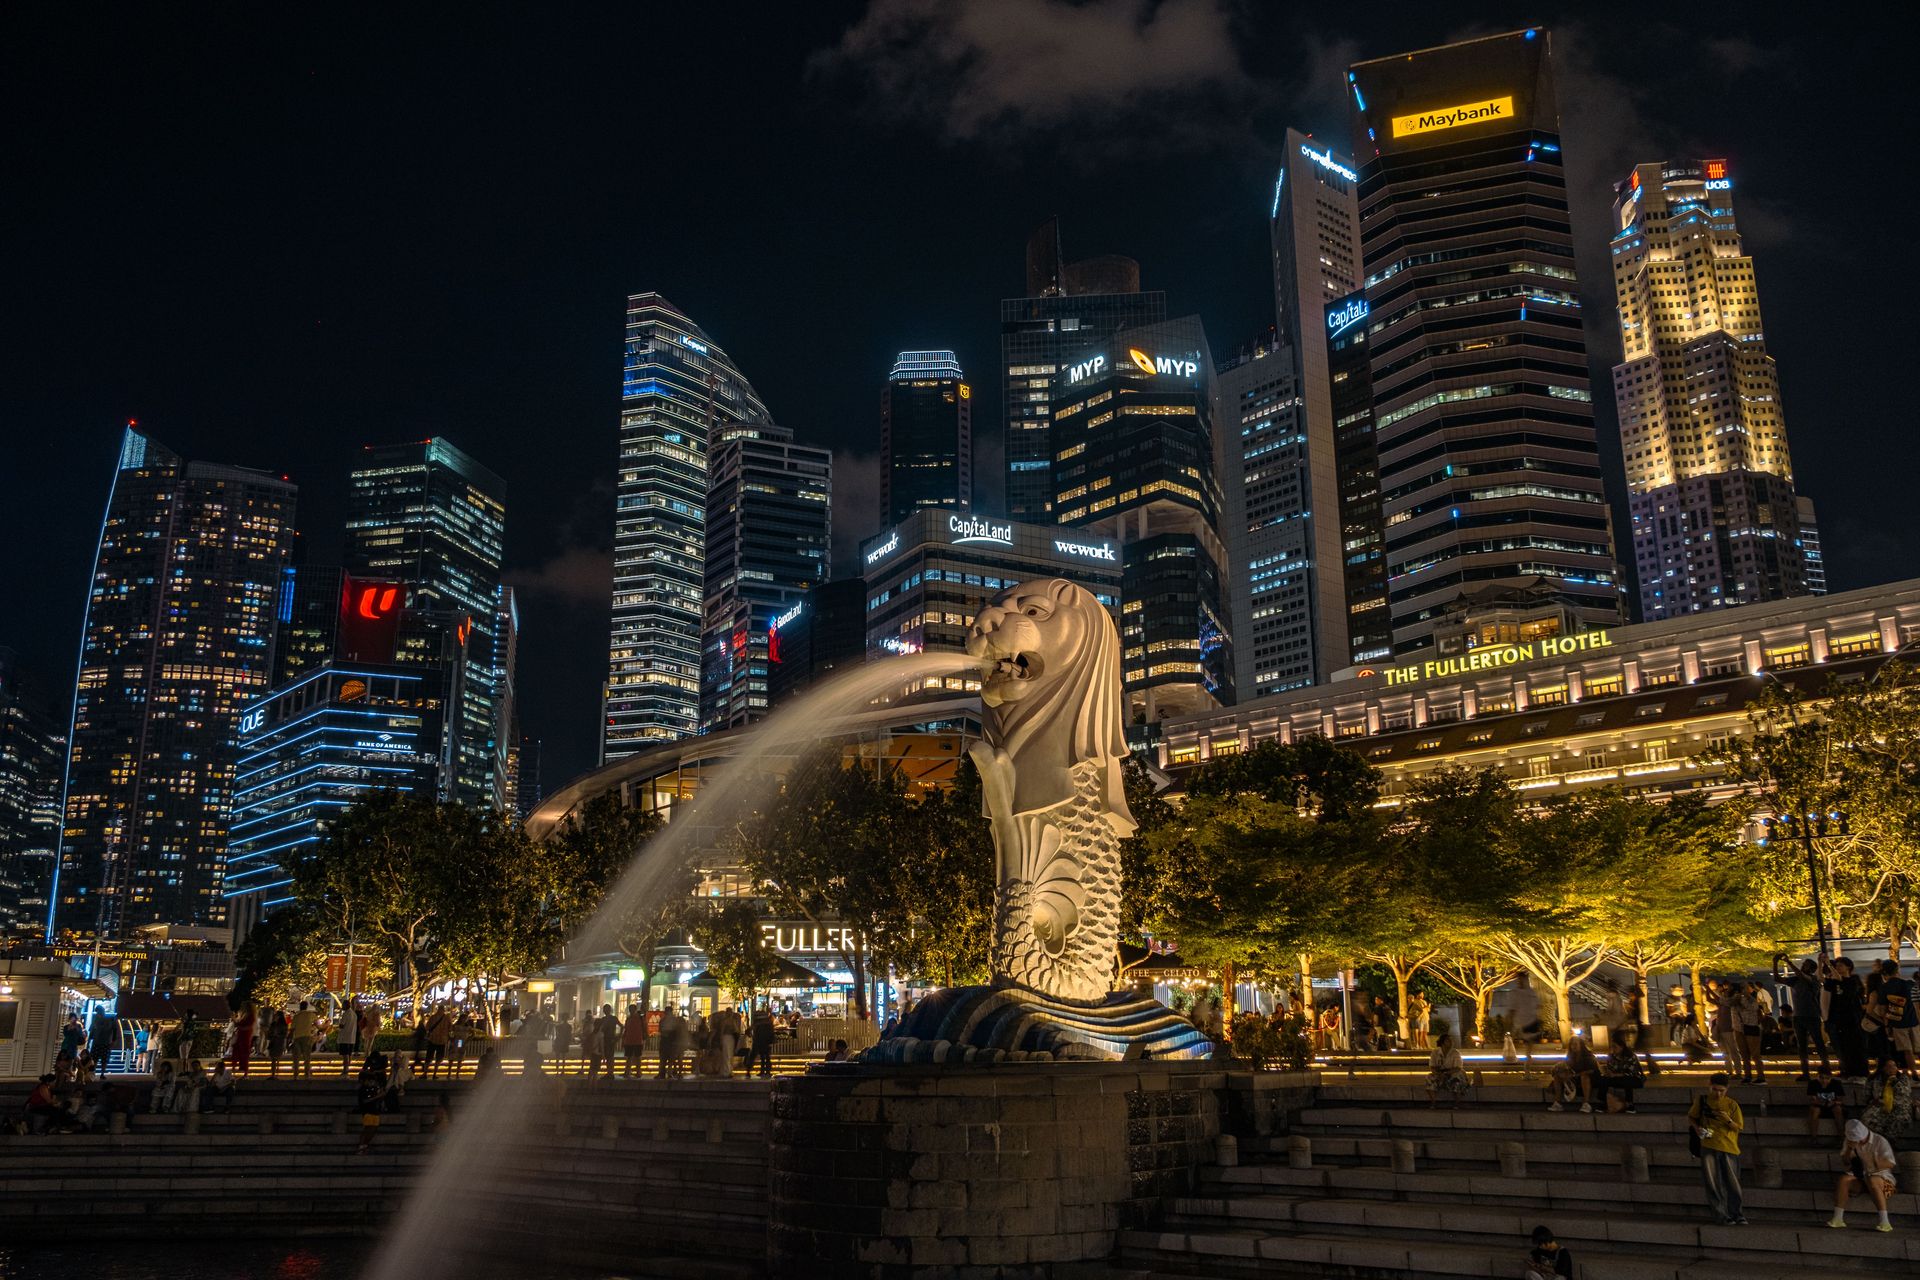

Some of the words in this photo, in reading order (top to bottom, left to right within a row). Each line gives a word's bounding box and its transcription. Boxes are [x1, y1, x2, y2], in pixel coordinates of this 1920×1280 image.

[1419, 103, 1501, 129] Maybank
[1705, 180, 1730, 189] UOB
[1070, 356, 1105, 383] MYP
[1156, 357, 1197, 377] MYP
[950, 516, 1011, 541] CapitaLand
[867, 532, 899, 564] wework
[1055, 541, 1116, 561] wework
[1384, 667, 1418, 686] THE
[1425, 644, 1533, 679] FULLERTON
[1542, 631, 1612, 658] HOTEL
[242, 709, 265, 733] OUE
[761, 925, 868, 951] FULLER
[54, 949, 68, 957] THE
[124, 951, 148, 959] HOTEL
[1163, 968, 1200, 977] GELATO
